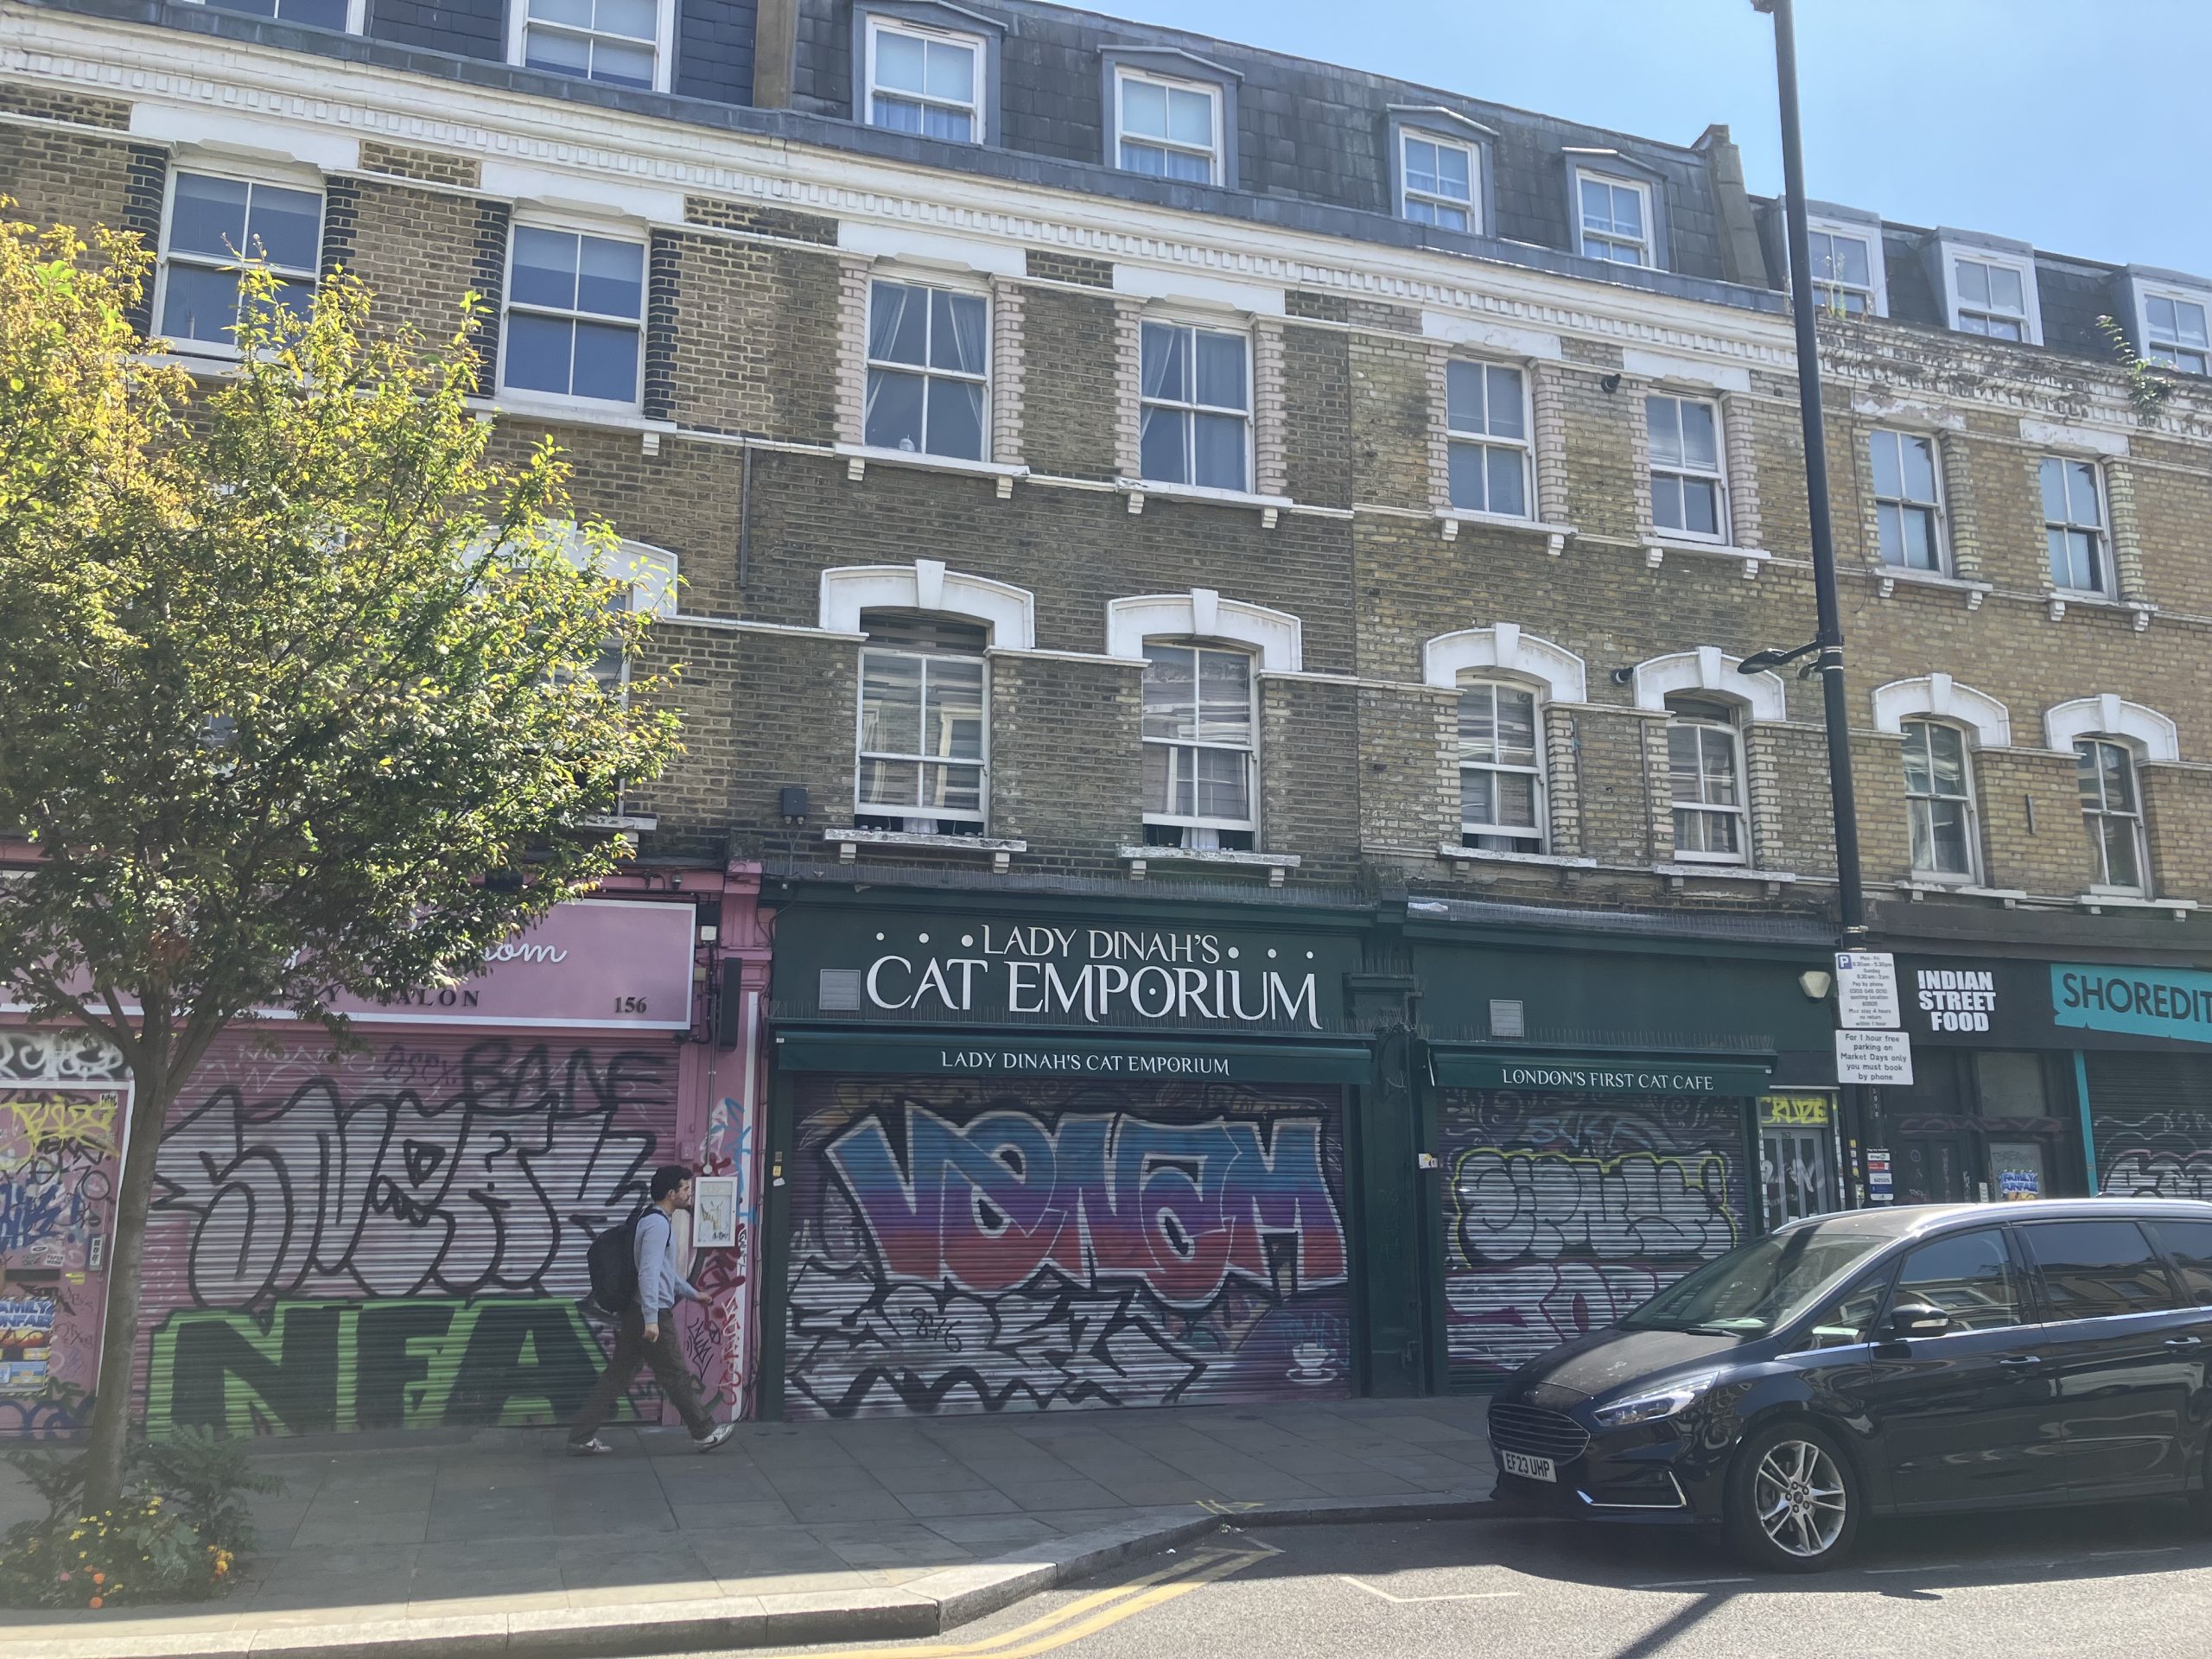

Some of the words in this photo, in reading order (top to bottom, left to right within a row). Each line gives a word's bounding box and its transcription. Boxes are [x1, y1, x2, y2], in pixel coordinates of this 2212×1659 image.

[981, 924, 1077, 957] LADY
[1087, 930, 1220, 964] DINAH'S
[1917, 969, 1994, 990] INDIAN
[866, 955, 988, 1010] CAT
[1003, 960, 1324, 1030] EMPORIUM
[1917, 990, 1996, 1012] STREET
[614, 996, 648, 1014] 156
[1930, 1011, 1990, 1032] FOOD
[941, 1051, 996, 1068] LADY
[1002, 1052, 1081, 1071] DINAH'S
[1086, 1054, 1123, 1071] CAT
[1128, 1056, 1230, 1077] EMPORIUM
[1870, 1053, 1889, 1062] Days
[1502, 1068, 1586, 1086] LONDON'S
[1589, 1072, 1635, 1088] FIRST
[1638, 1073, 1669, 1090] CAT
[1673, 1076, 1714, 1090] CAFE
[1505, 1452, 1529, 1474] EF23
[1529, 1458, 1550, 1478] UHP
